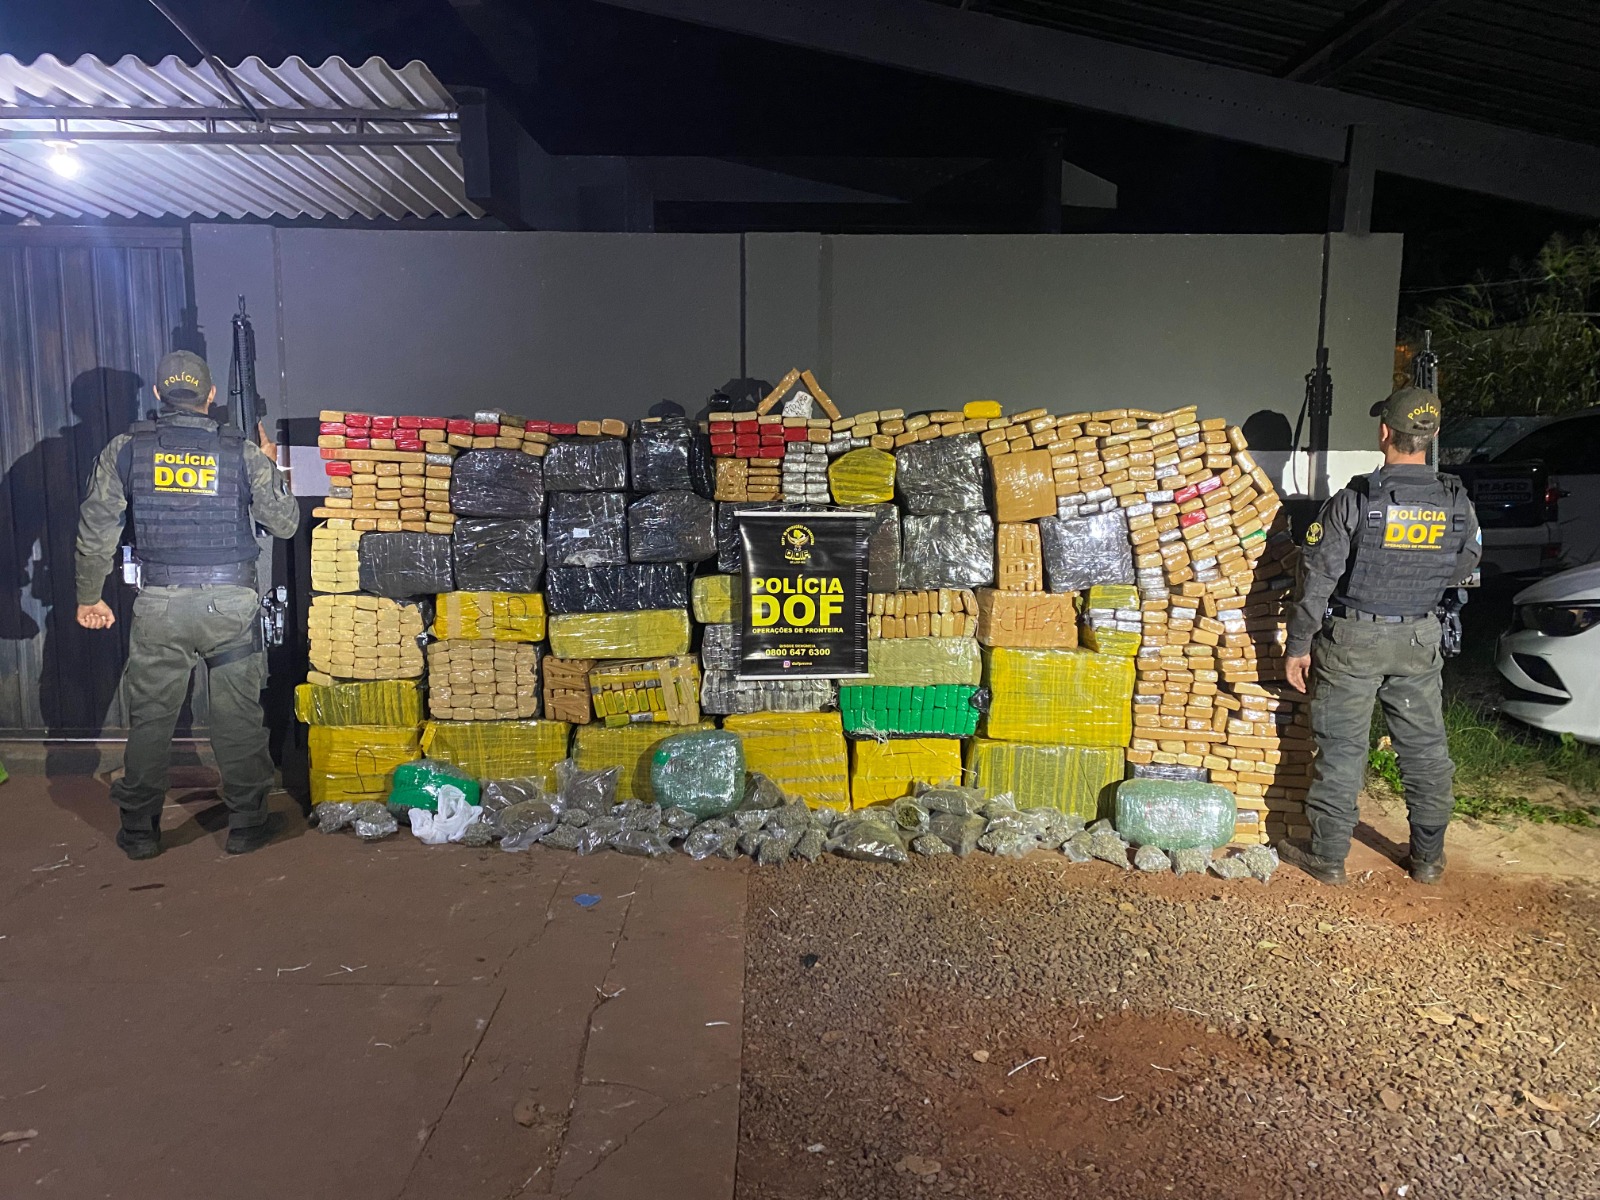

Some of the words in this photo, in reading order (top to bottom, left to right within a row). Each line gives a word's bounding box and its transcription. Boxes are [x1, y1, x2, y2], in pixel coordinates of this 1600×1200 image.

[164, 372, 200, 387] POLÍCIA
[1407, 403, 1439, 421] POLÍCIA
[155, 453, 216, 466] POLÍCIA
[154, 466, 217, 488] DOF
[1389, 508, 1446, 522] POLÍCIA
[1384, 523, 1446, 544] DOF
[751, 574, 844, 594] POLÍCIA
[752, 594, 844, 627] DOF
[765, 648, 787, 656] 0800
[789, 648, 806, 656] 647
[808, 648, 831, 656] 6300
